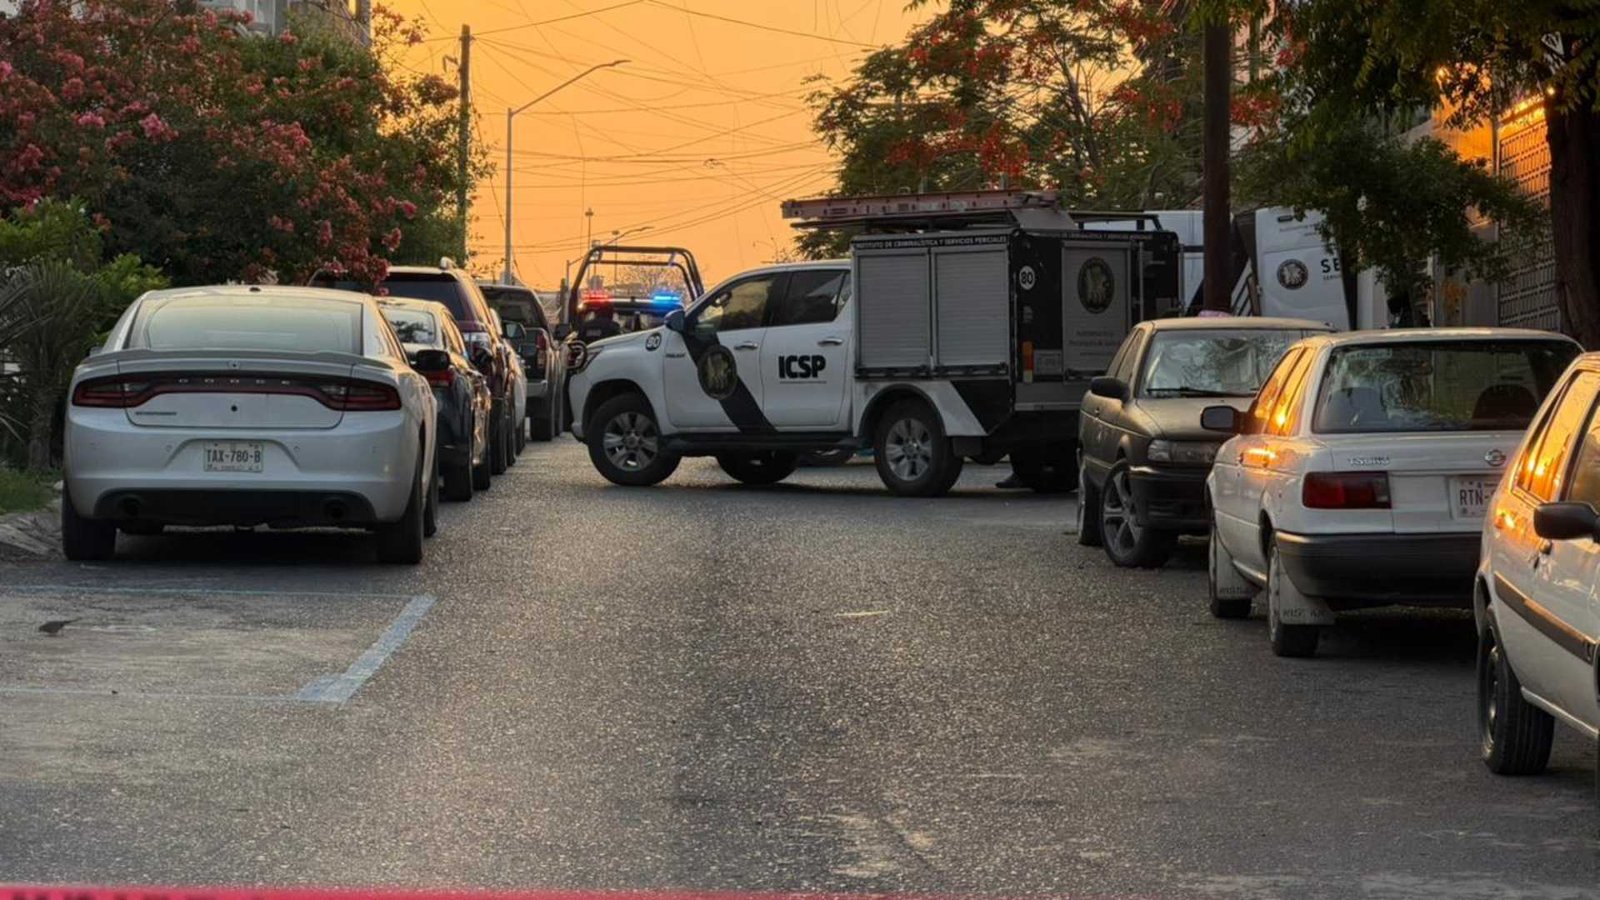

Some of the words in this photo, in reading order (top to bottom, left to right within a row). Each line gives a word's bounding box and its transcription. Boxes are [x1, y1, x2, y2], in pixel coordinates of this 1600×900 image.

[1021, 271, 1034, 285] 80
[647, 336, 660, 348] 80
[778, 355, 827, 379] ICSP
[207, 449, 261, 463] TAX-780-B
